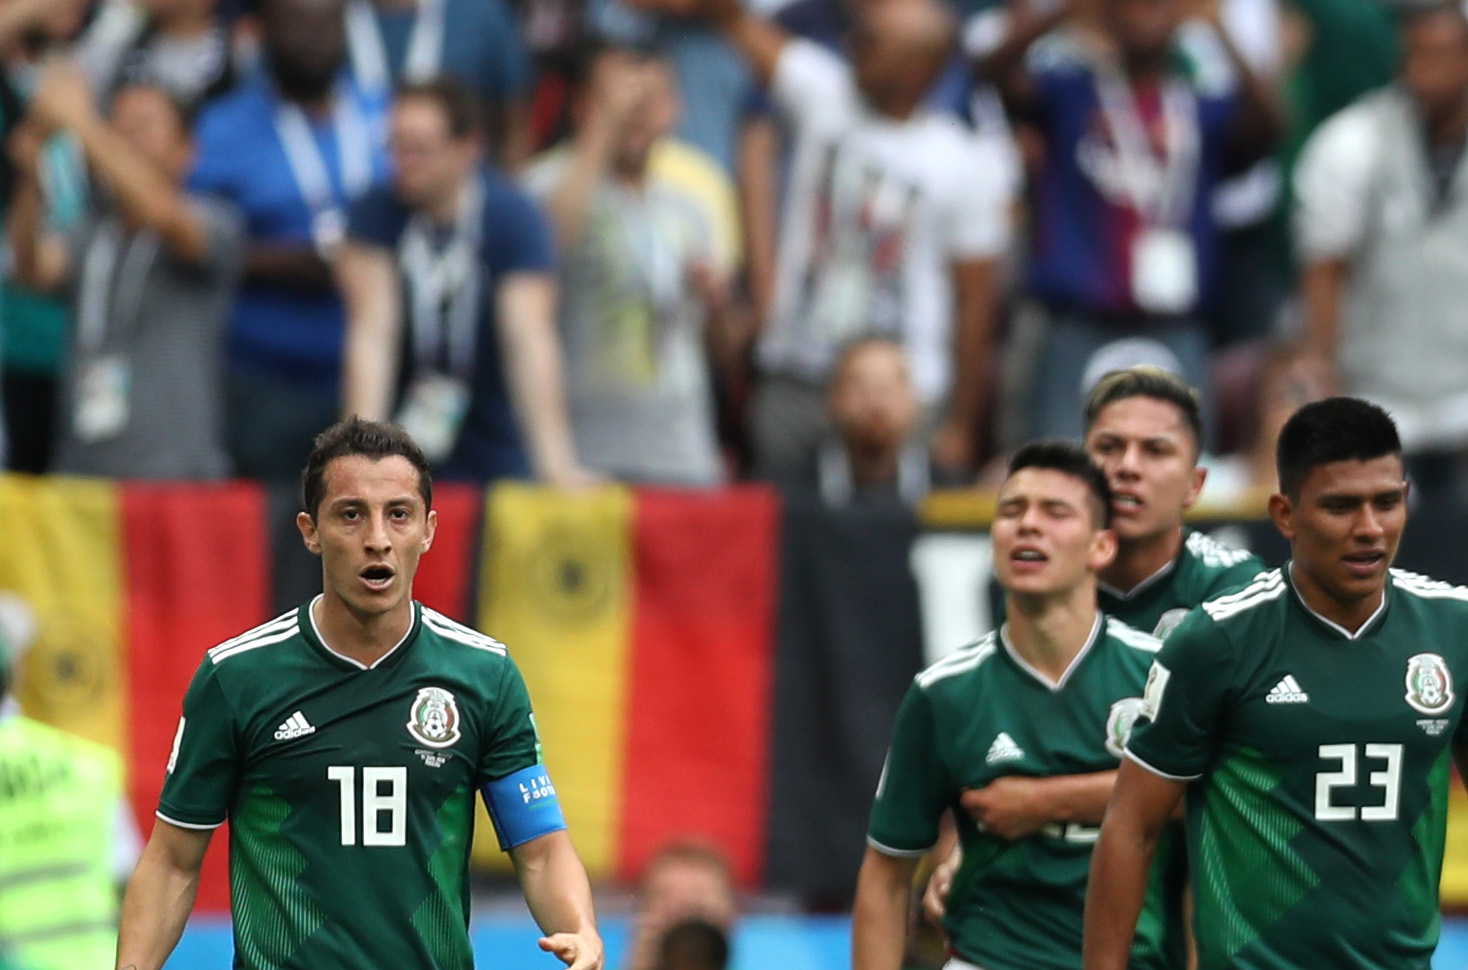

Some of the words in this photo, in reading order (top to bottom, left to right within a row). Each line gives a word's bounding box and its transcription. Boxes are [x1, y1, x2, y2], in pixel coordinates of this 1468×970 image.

[1265, 692, 1309, 703] adidas
[327, 766, 408, 847] 18
[1315, 743, 1404, 821] 23
